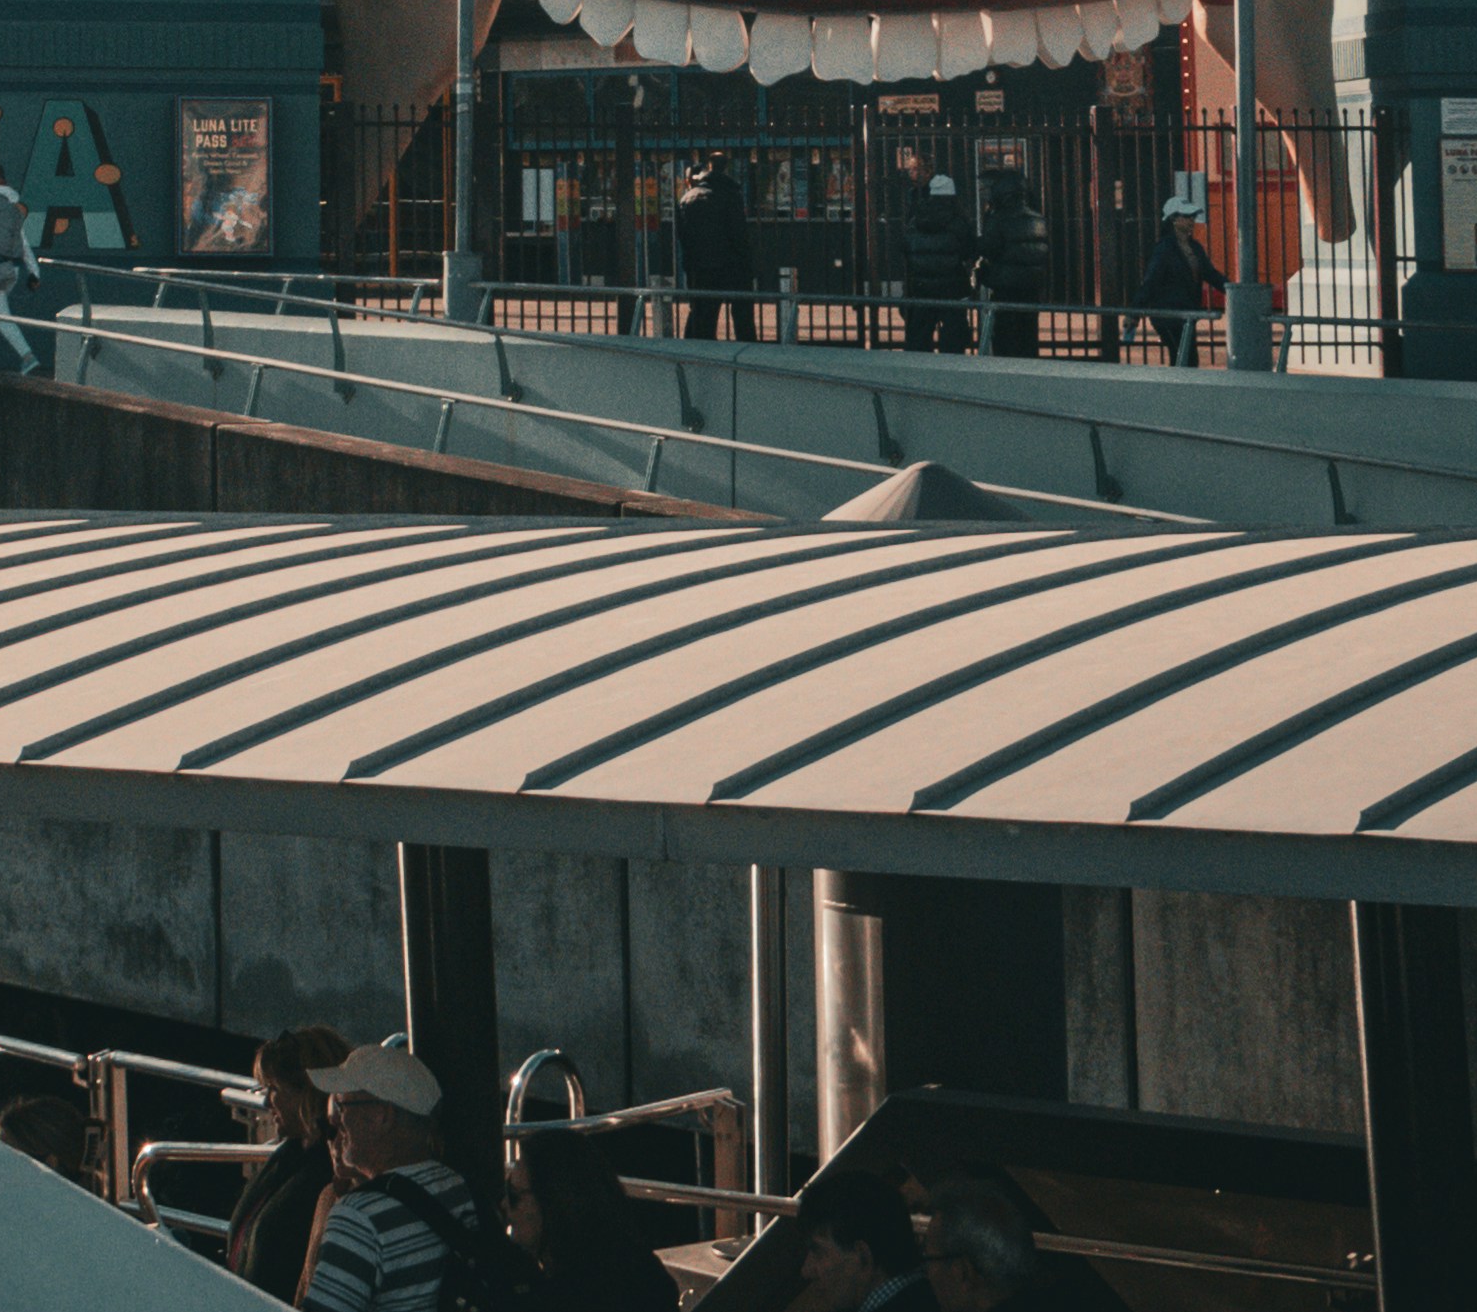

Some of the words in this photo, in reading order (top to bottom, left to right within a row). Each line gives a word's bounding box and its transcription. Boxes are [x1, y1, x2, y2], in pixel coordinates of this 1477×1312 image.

[192, 118, 226, 133] LUNA
[230, 118, 258, 133] LITE
[195, 134, 228, 149] PASS
